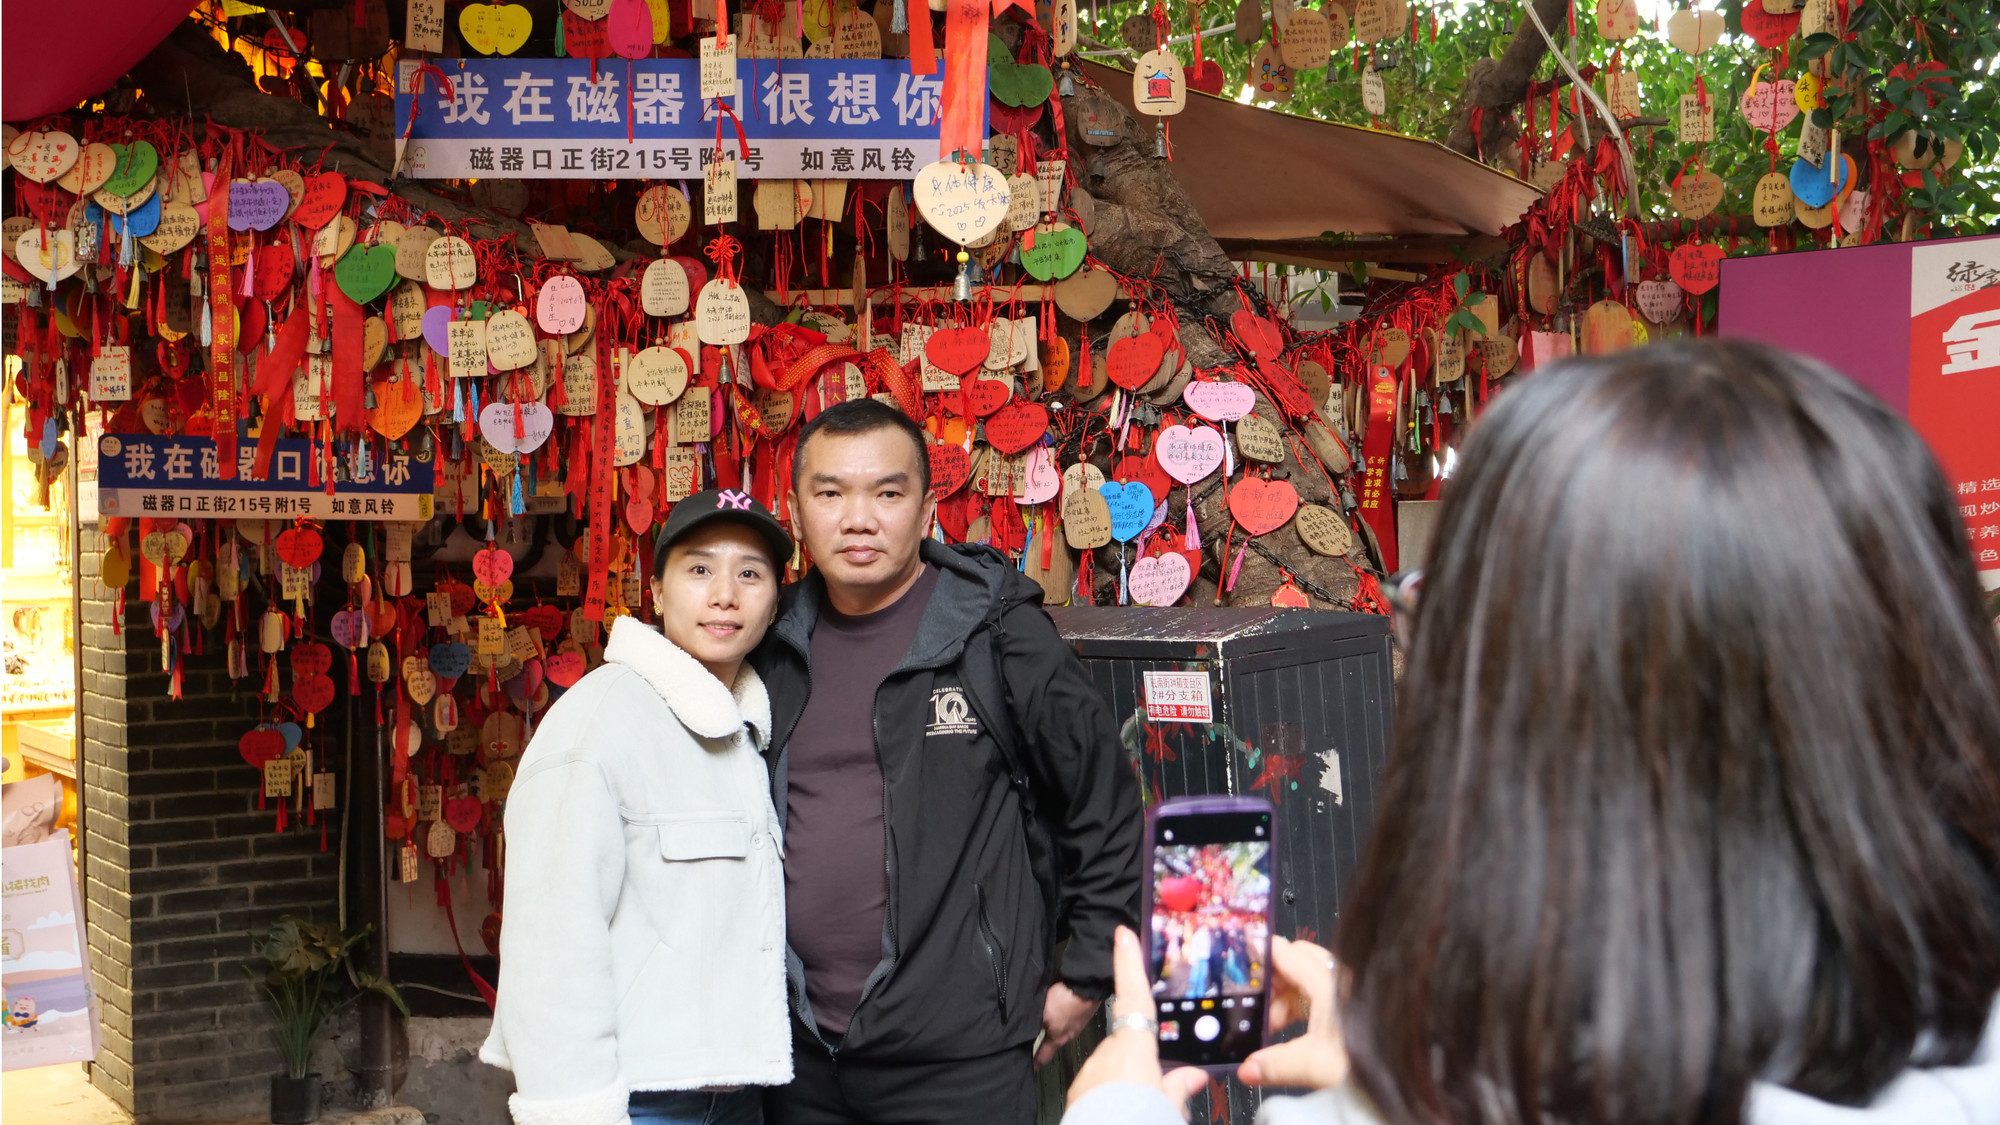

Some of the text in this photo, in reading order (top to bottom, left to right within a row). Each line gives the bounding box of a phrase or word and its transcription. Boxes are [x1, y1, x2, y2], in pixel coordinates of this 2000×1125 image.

[438, 71, 943, 126] 我在磁器口很想你
[801, 147, 916, 172] 如意风铃
[946, 203, 971, 217] 2025
[212, 236, 230, 401] 鸿运高照 家运昌隆
[1958, 477, 2000, 495] 精选
[142, 494, 395, 515] 磁器口正街215号附1号 如意风铃
[1152, 690, 1203, 702] 2#分支箱
[1148, 705, 1210, 718] 有电危险 请勿触碰
